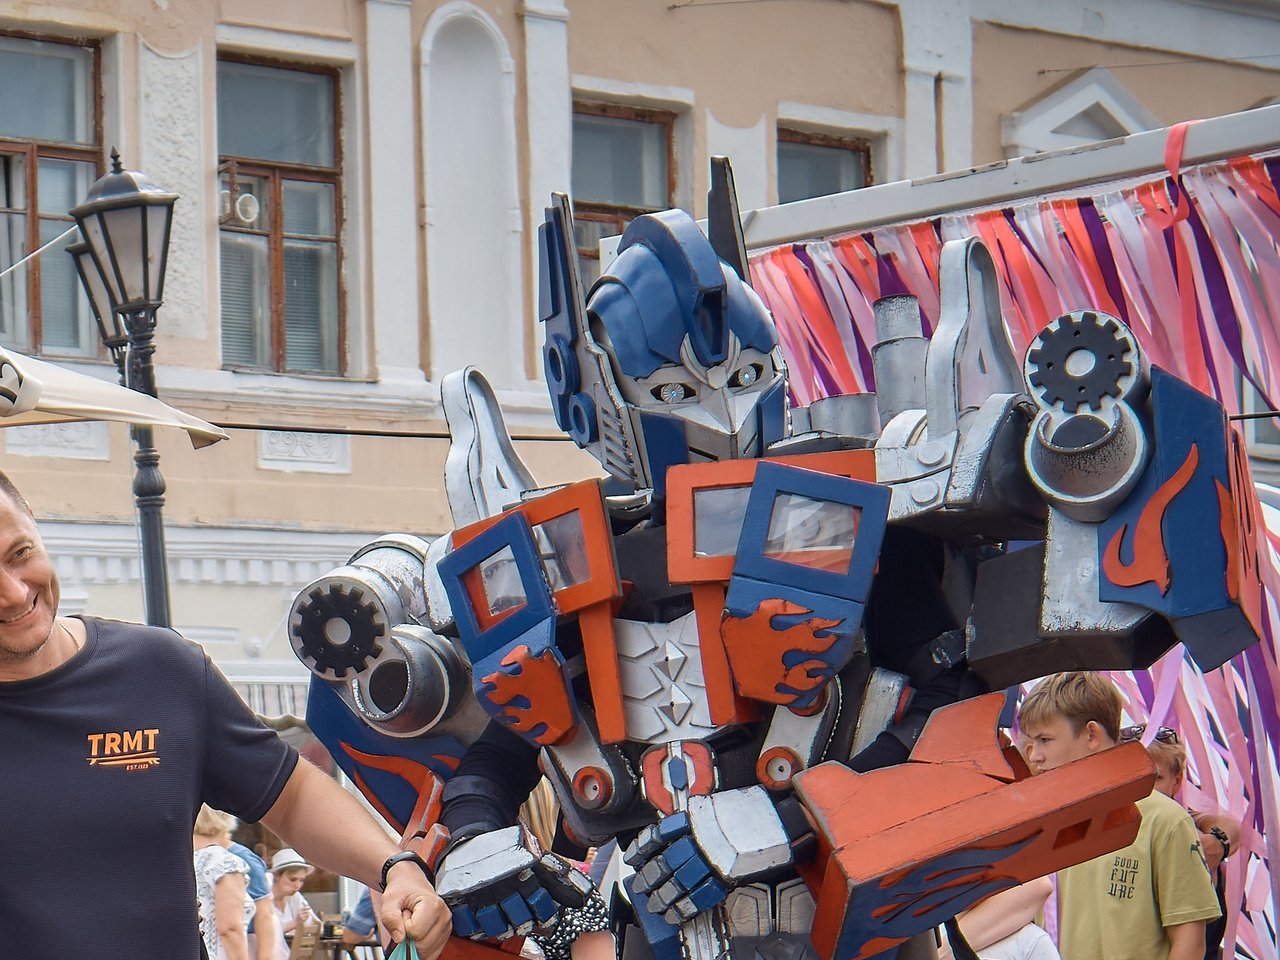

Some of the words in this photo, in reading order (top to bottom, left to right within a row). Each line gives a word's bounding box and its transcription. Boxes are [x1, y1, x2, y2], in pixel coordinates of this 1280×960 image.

[87, 728, 160, 756] TRMT
[1113, 856, 1139, 870] GOOD
[1110, 868, 1138, 884] FUT
[1108, 883, 1135, 899] URE
